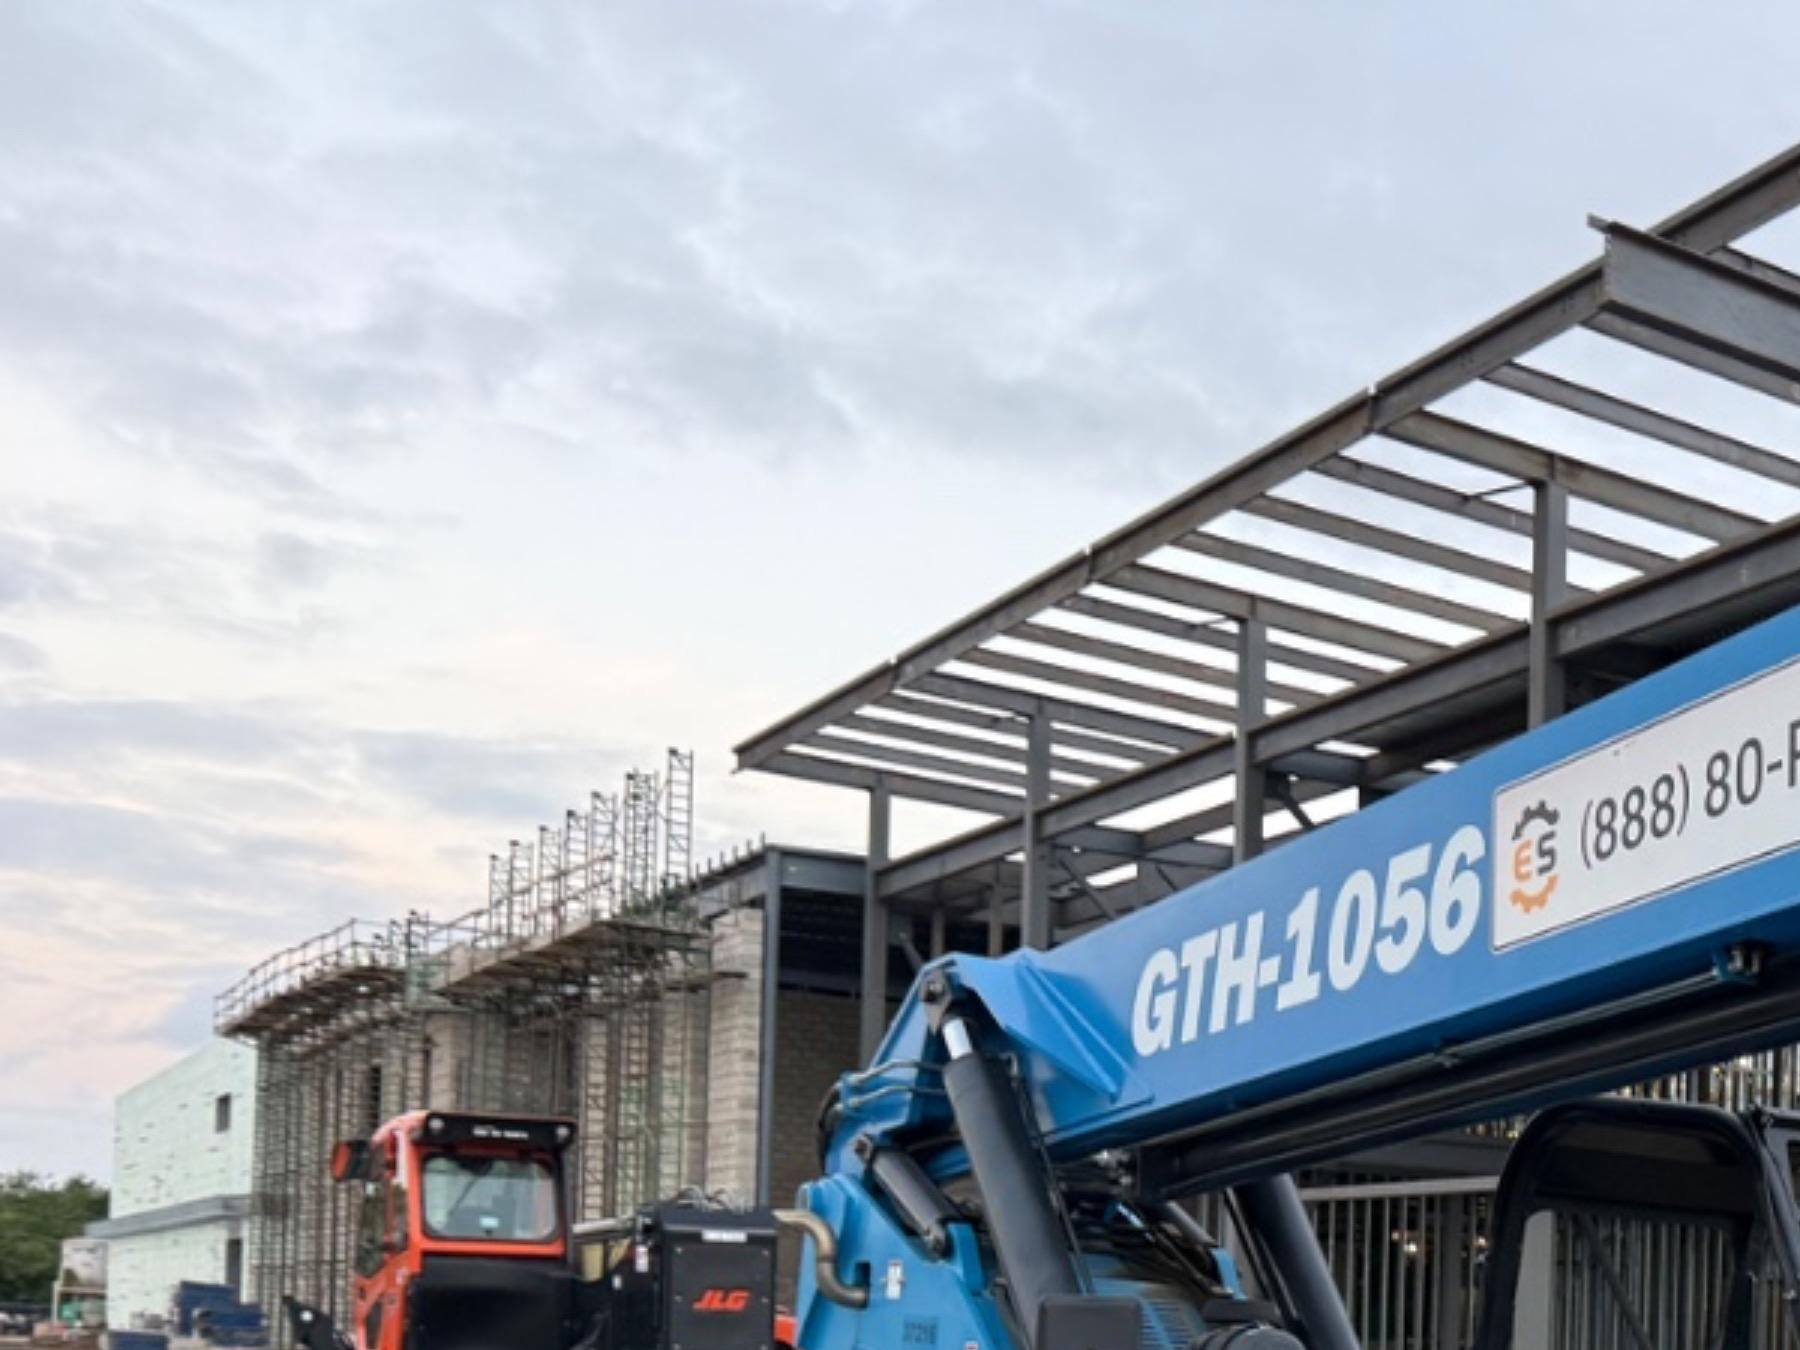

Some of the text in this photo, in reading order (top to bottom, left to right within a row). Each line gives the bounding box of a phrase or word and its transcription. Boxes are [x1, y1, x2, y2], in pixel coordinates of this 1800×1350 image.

[1581, 764, 1690, 869] (888)
[1131, 825, 1486, 1056] GTH-1056
[692, 1289, 750, 1311] JLG
